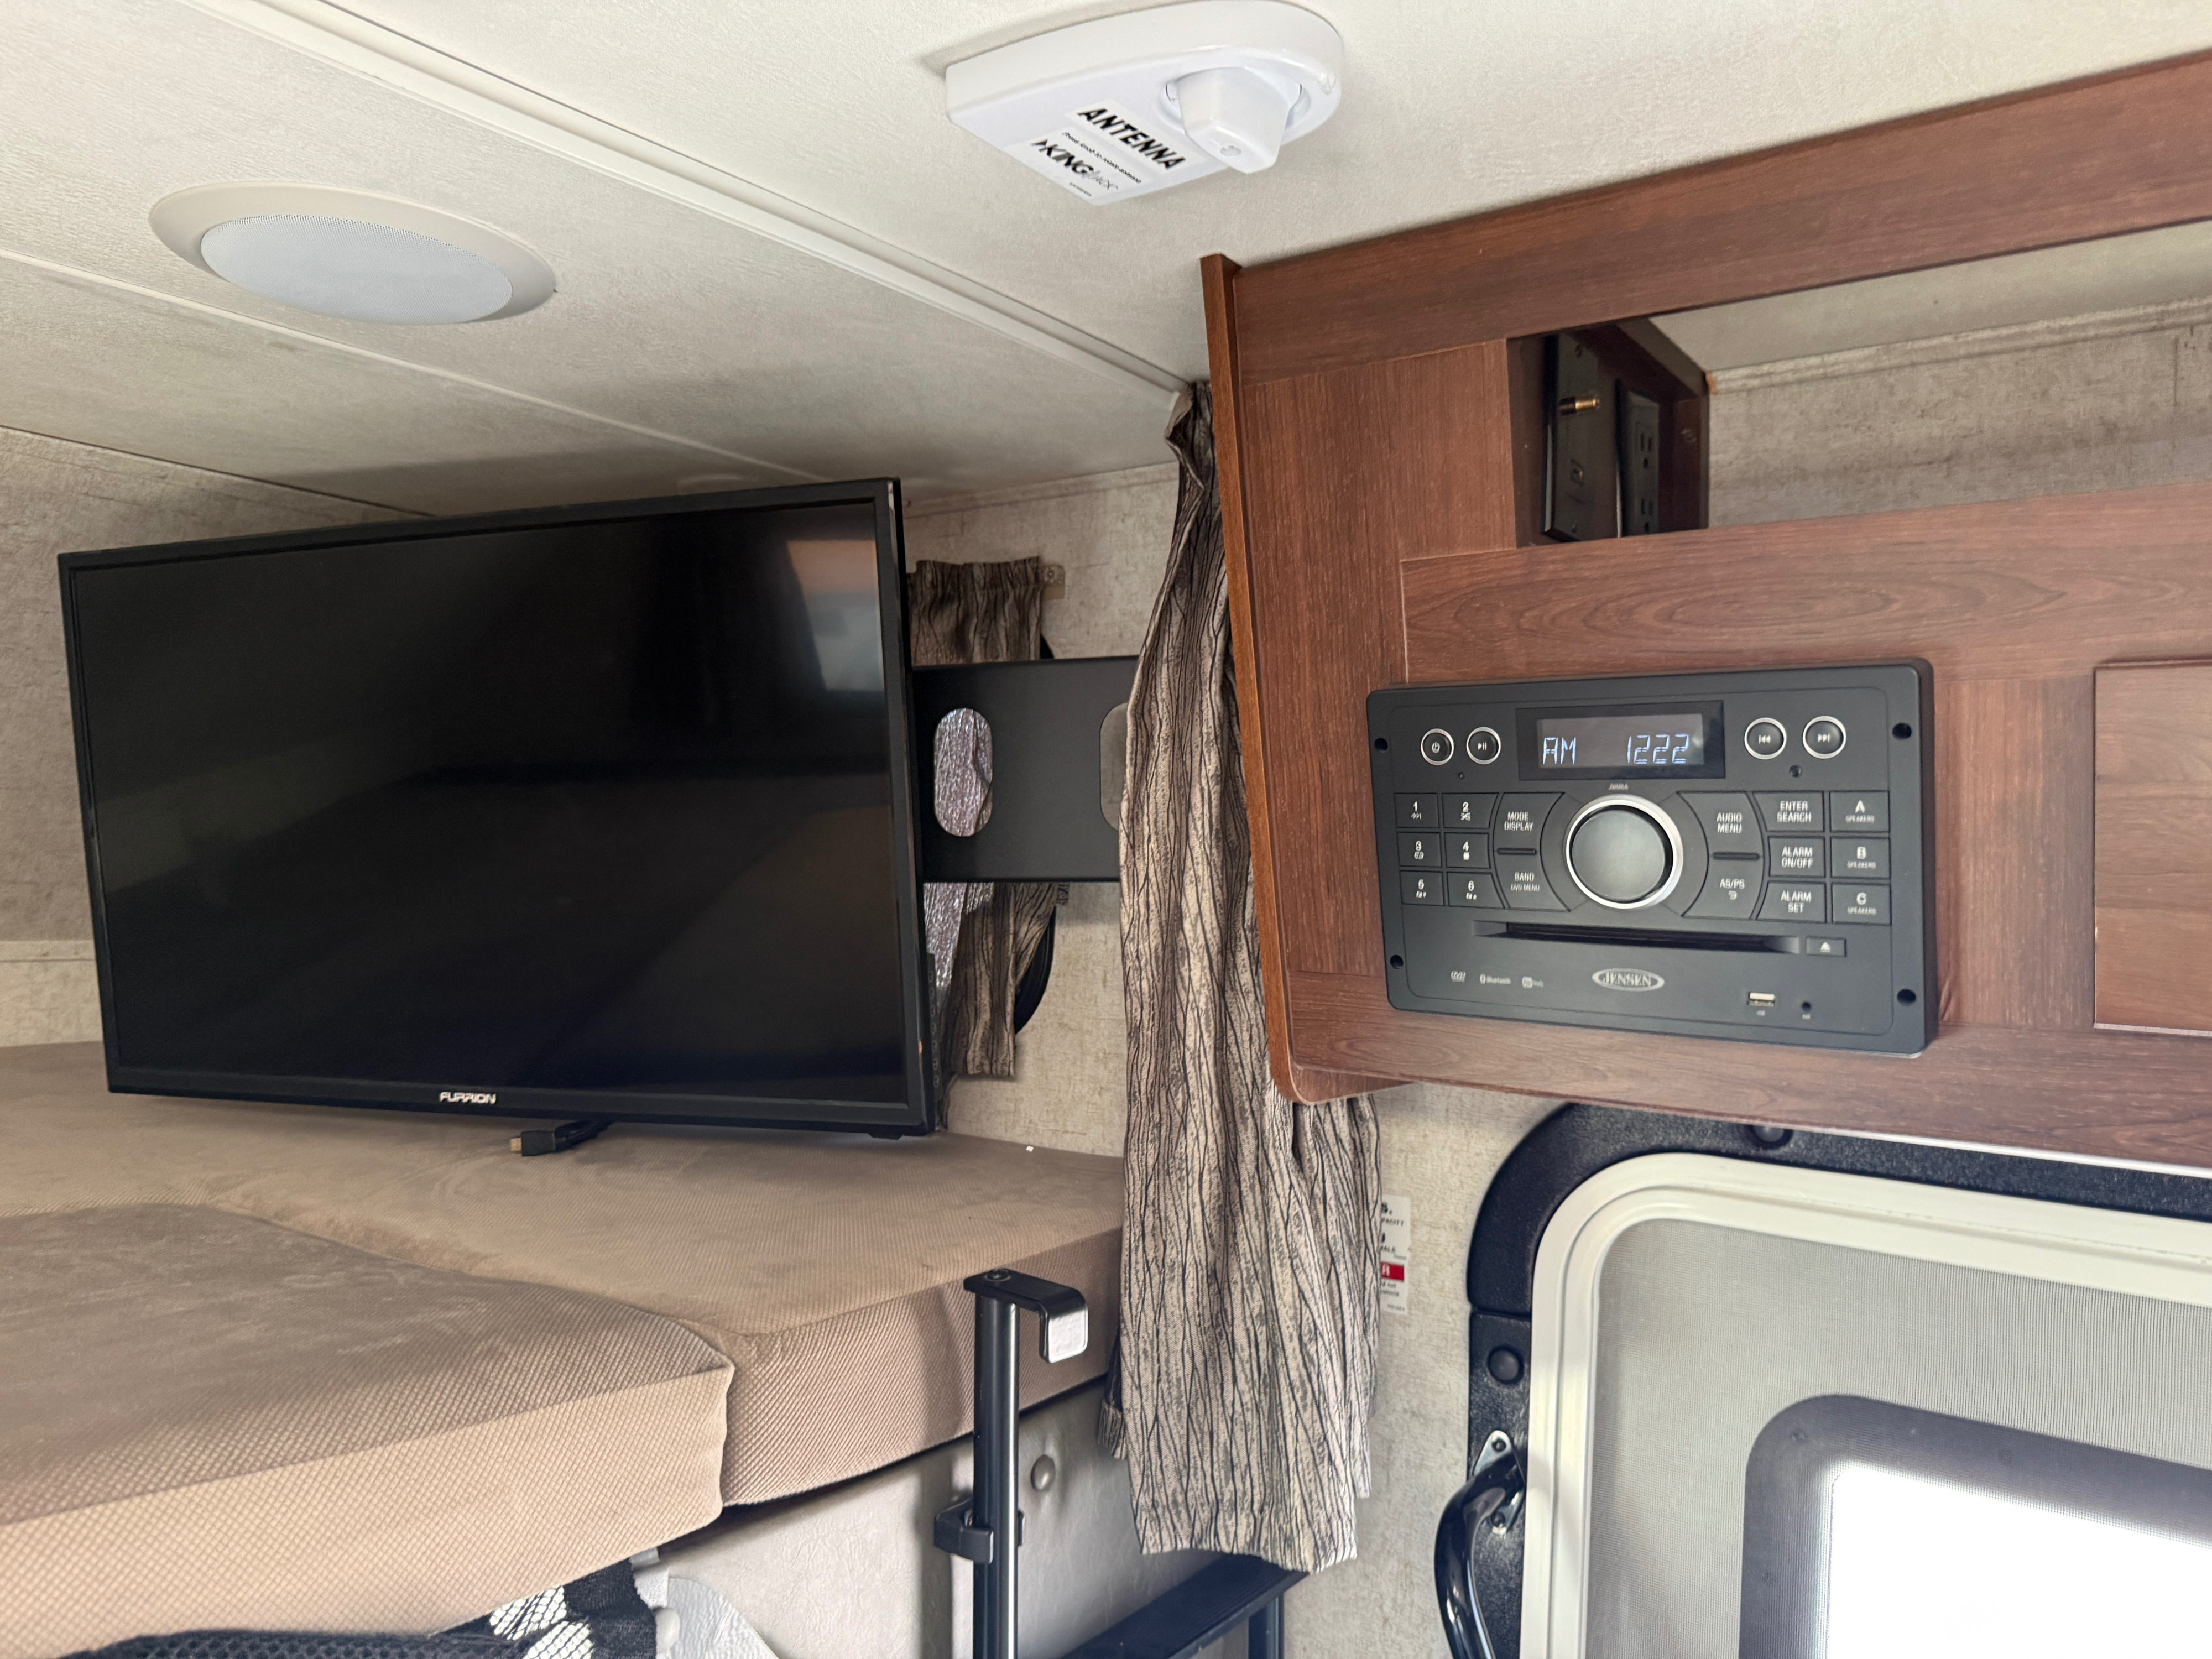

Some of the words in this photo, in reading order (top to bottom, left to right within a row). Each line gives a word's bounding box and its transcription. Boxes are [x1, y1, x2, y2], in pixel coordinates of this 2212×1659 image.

[1077, 108, 1186, 170] ANTENNA
[1543, 737, 1576, 764] AM
[1413, 801, 1418, 812] 1
[1462, 802, 1469, 812] 2
[1780, 801, 1808, 811] ENTER
[1855, 800, 1865, 813] A
[1507, 811, 1529, 821] MODE
[1717, 812, 1742, 823] AUDIO
[1777, 811, 1811, 822] SEARCH
[1504, 821, 1533, 831] DISPLAY
[1718, 822, 1742, 833] MENU
[1416, 841, 1422, 851] 3
[1463, 841, 1469, 851] 4
[1782, 846, 1812, 857] ALARM
[1856, 847, 1866, 859] B
[1781, 857, 1813, 868] ON/OFF
[1515, 872, 1535, 881] BAND
[1418, 879, 1425, 890] 5
[1468, 880, 1474, 891] 6
[1720, 878, 1745, 889] AS/PS
[1781, 890, 1811, 902] ALARM
[1856, 892, 1866, 905] C
[1788, 902, 1804, 912] SET
[1603, 972, 1651, 987] JENSEN
[440, 1092, 497, 1104] FURRION
